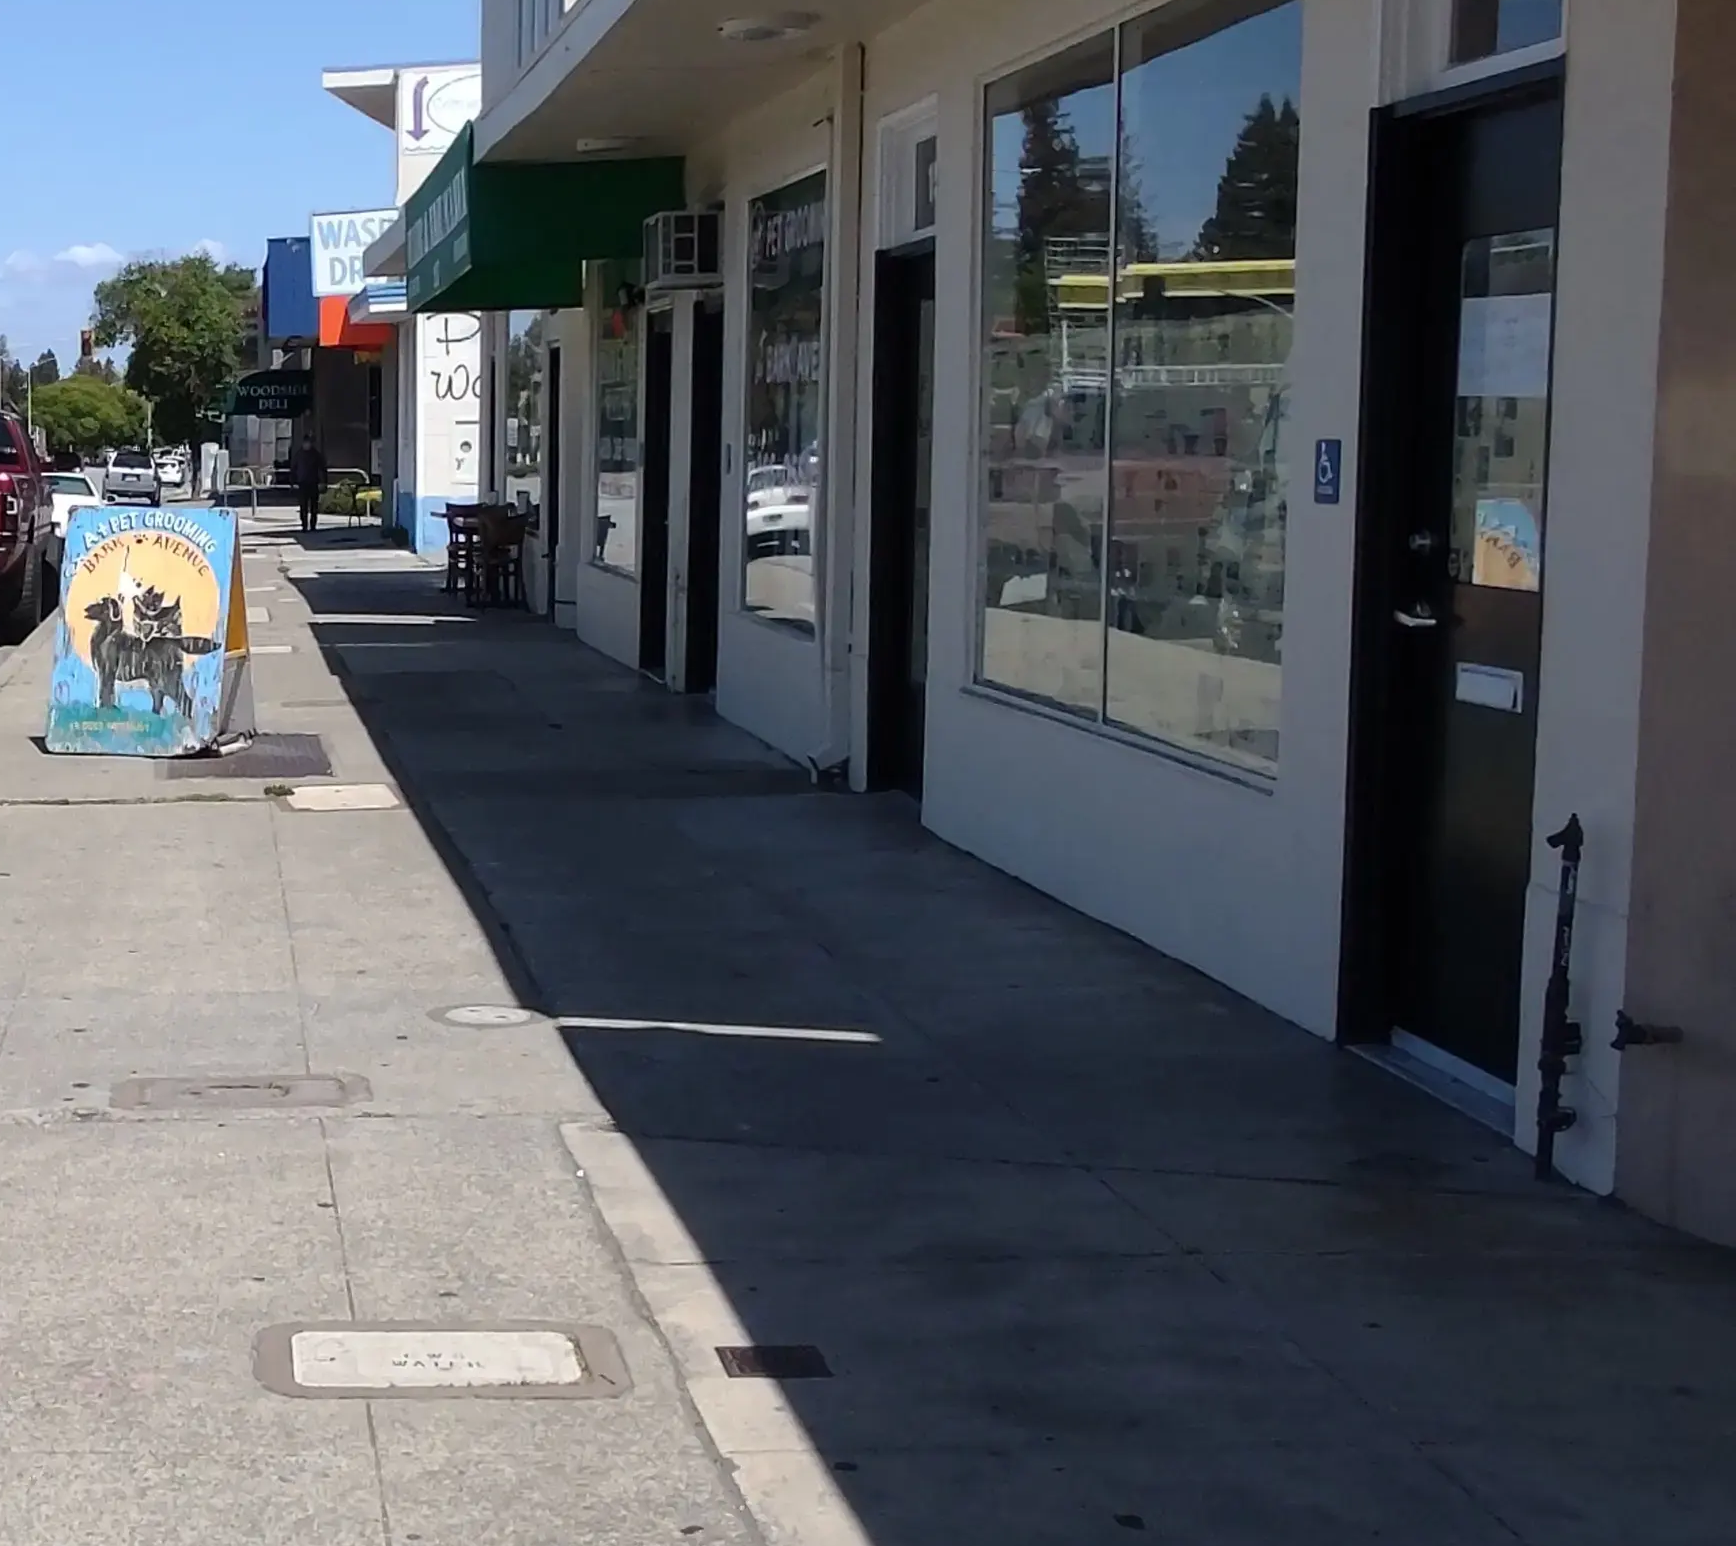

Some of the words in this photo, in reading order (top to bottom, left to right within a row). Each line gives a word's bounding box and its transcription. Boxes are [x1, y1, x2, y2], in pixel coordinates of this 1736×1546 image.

[236, 384, 310, 398] WOODSIDE
[259, 398, 288, 410] DELI
[110, 513, 139, 533] PET
[144, 512, 217, 553] GROOMING
[83, 538, 124, 574] BARK
[153, 535, 209, 576] AVENUE
